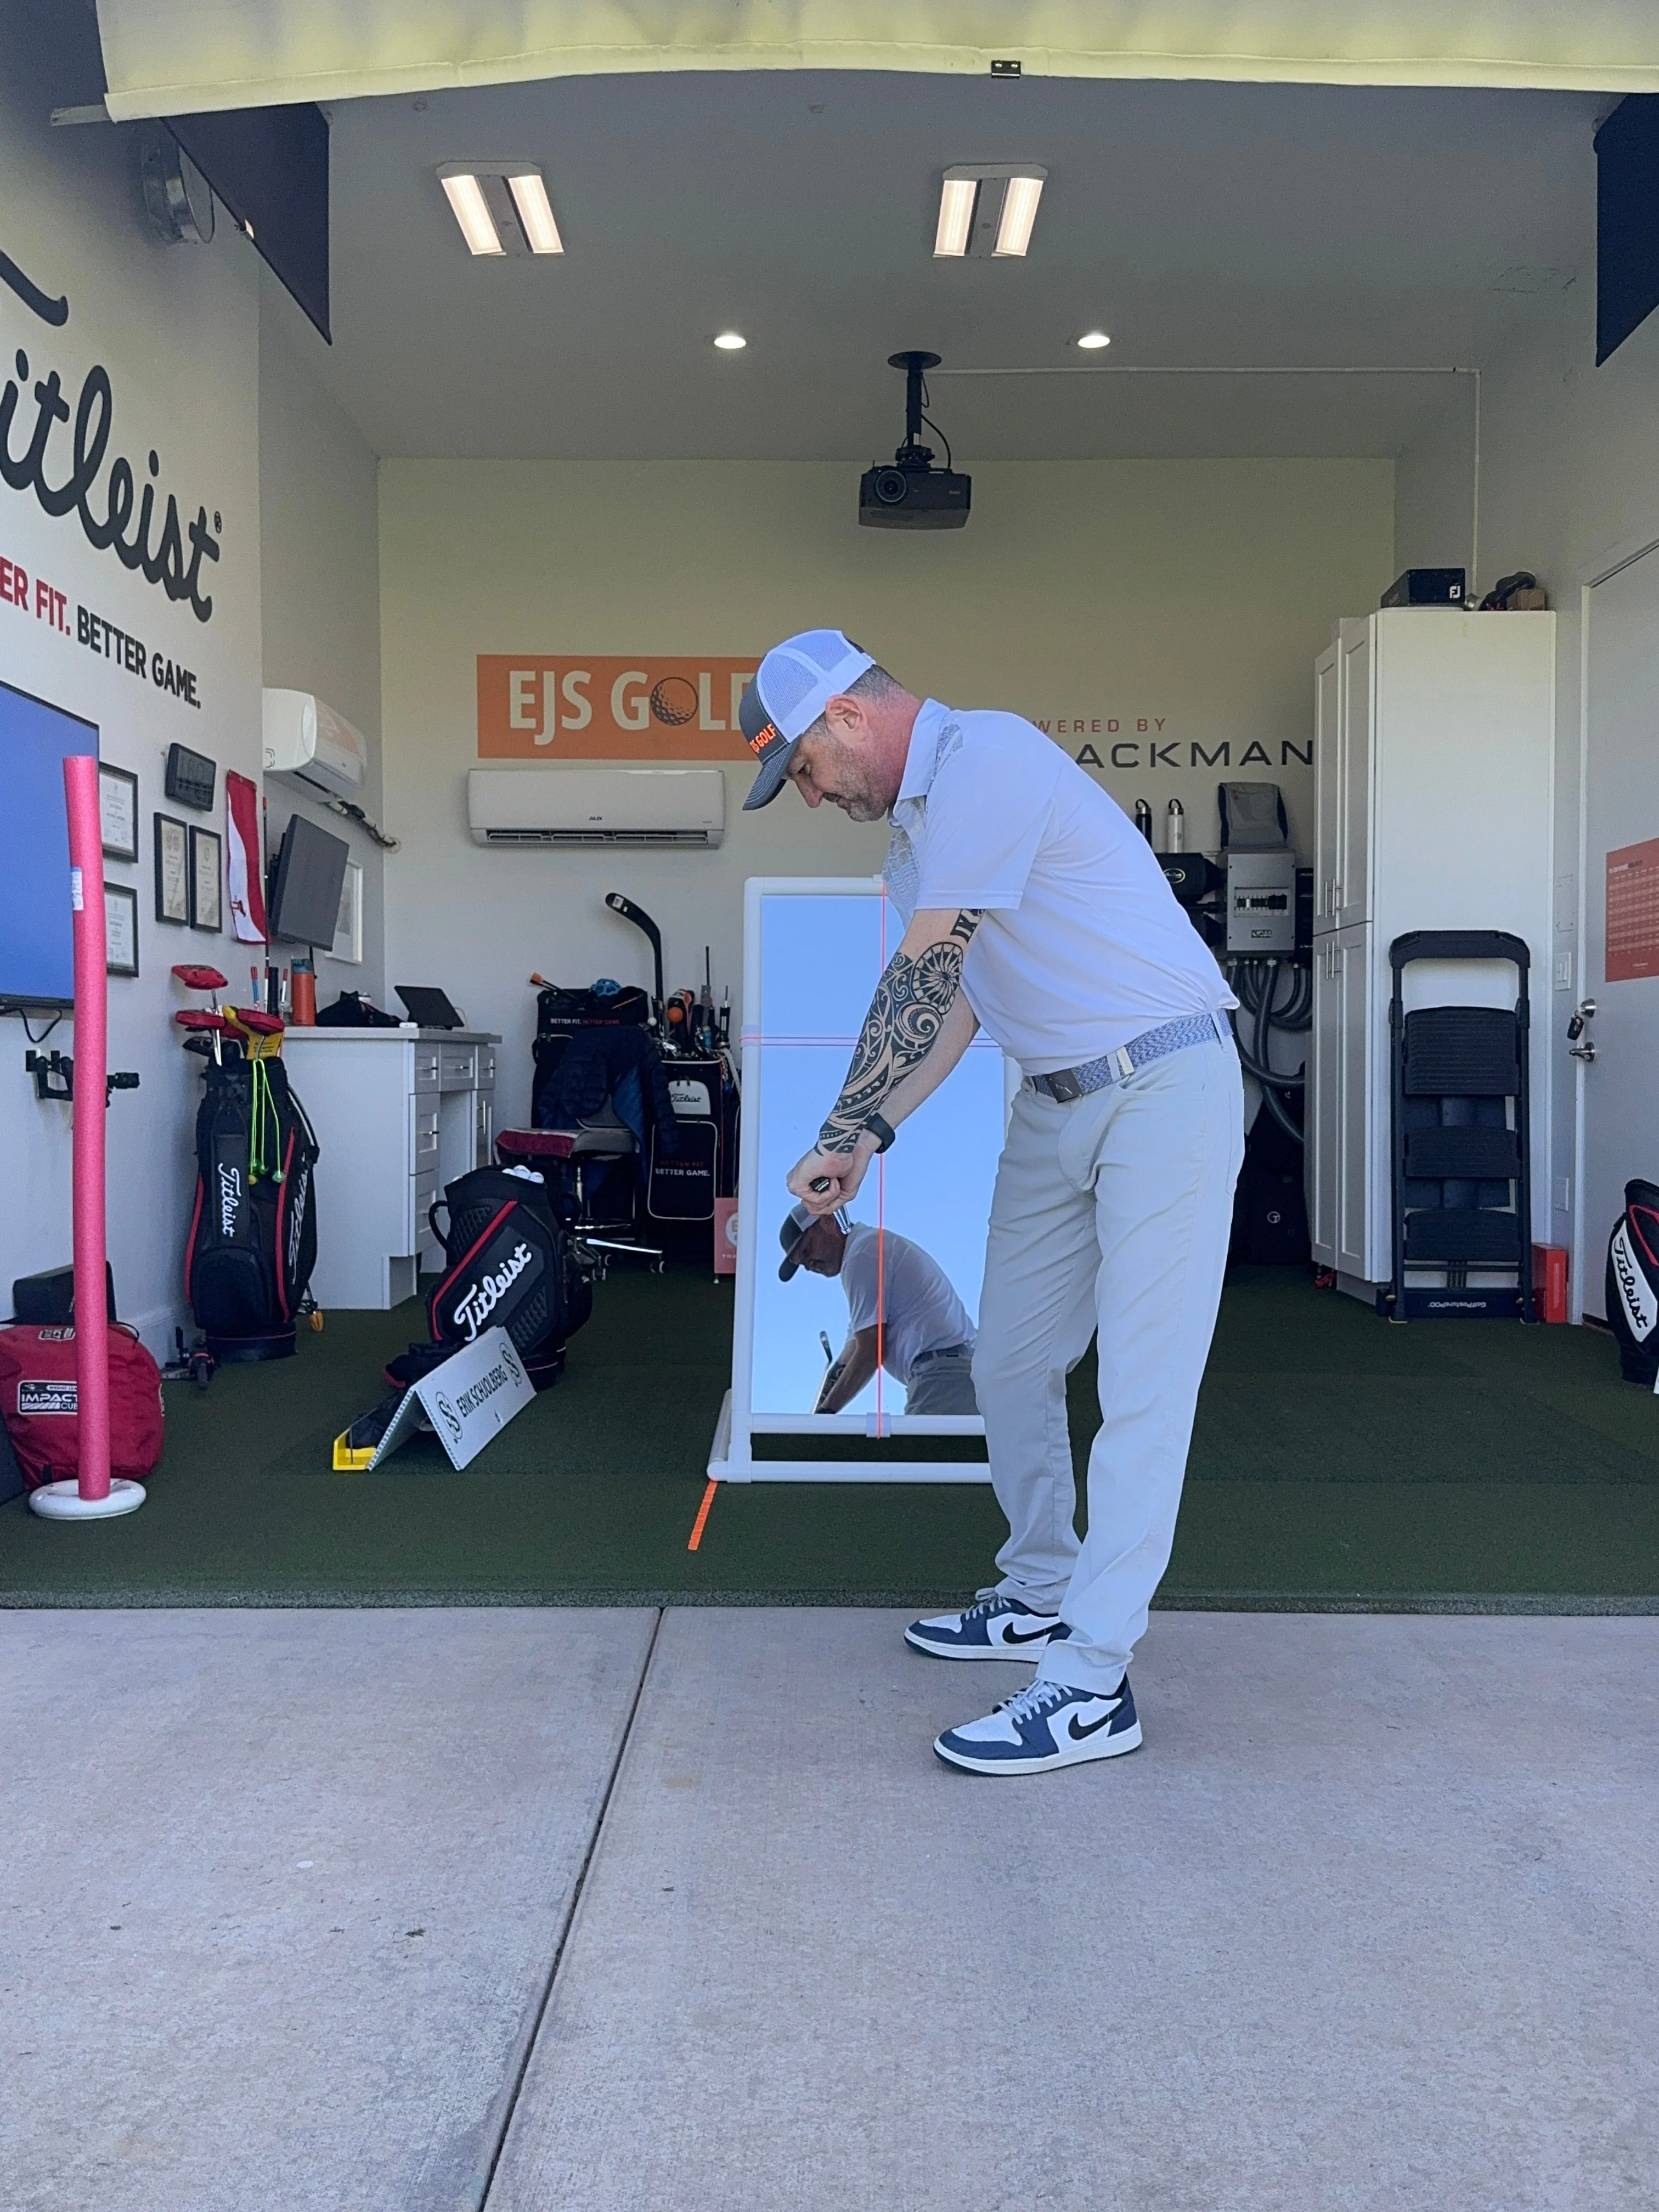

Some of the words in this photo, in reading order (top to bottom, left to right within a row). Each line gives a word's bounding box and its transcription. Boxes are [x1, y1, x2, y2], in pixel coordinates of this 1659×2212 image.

[0, 250, 220, 622] itleist
[36, 579, 70, 636] FIT.
[77, 605, 146, 679] BETTER
[152, 652, 201, 709] GAME.
[510, 670, 592, 746] EJS
[755, 723, 776, 747] GOLF
[1033, 719, 1120, 733] WERED
[1137, 718, 1166, 732] BY
[1060, 740, 1313, 768] ACKMAN
[671, 1093, 702, 1103] Titleist
[218, 1163, 241, 1237] Titleist
[454, 1243, 532, 1342] Titleist
[1614, 1237, 1648, 1329] Titleist
[456, 1391, 476, 1418] ERIK
[470, 1364, 508, 1407] SCHJOLBERG
